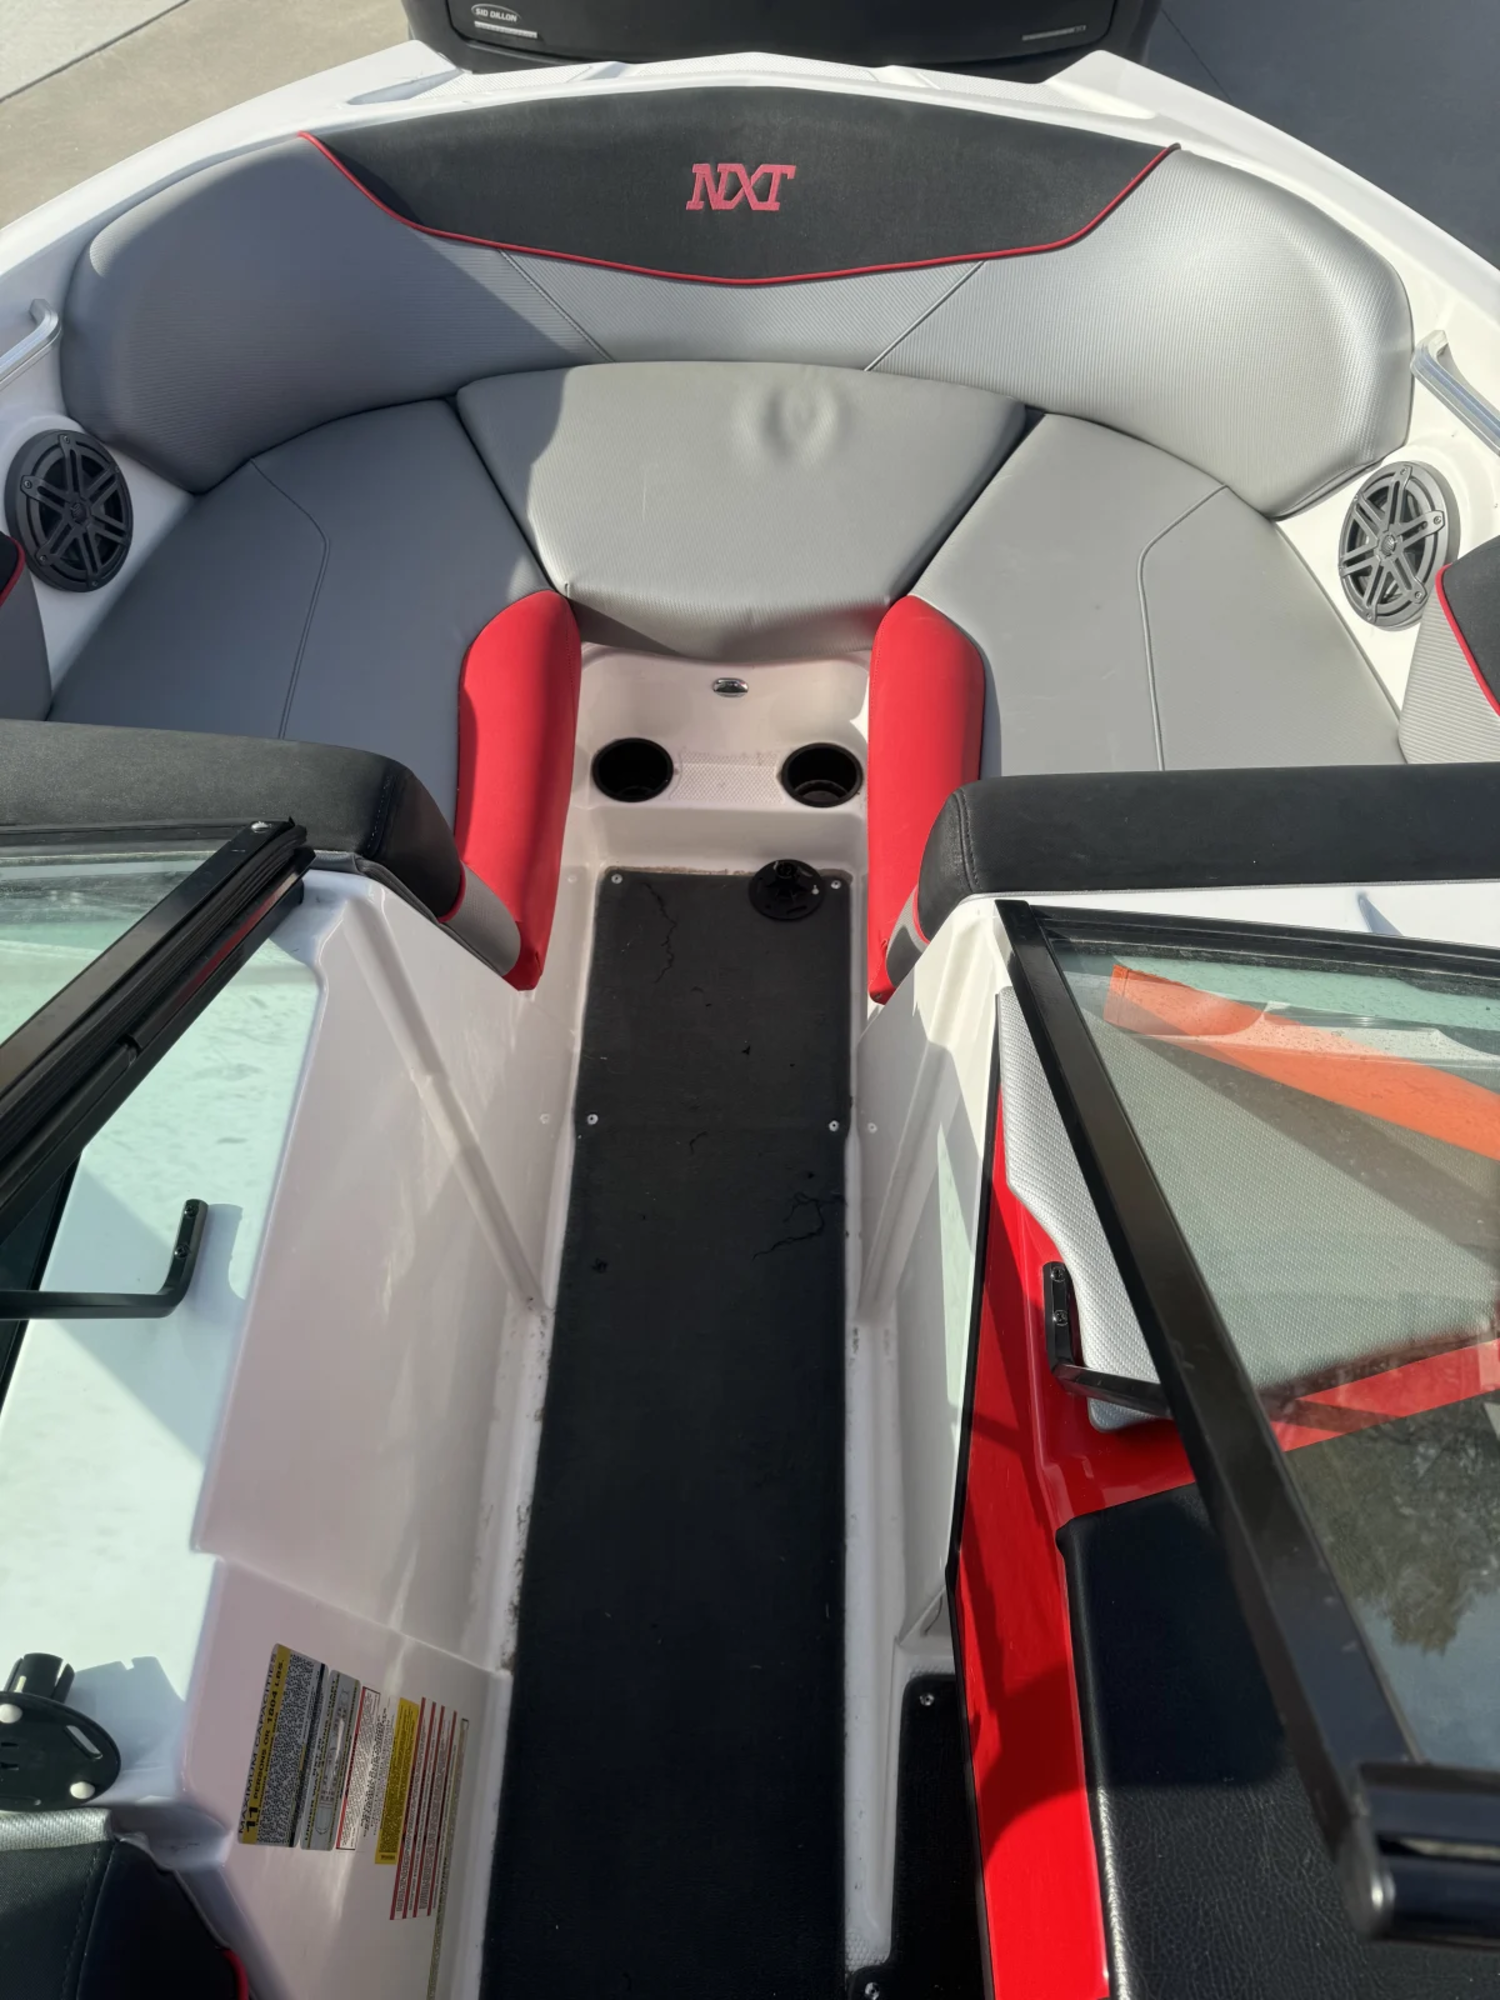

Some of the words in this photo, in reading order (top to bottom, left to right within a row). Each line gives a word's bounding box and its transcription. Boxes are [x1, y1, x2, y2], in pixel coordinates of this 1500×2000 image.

[475, 7, 489, 17] SID
[489, 10, 517, 22] DILLON
[685, 163, 797, 211] NXT
[238, 1753, 257, 1834] MAXIMUM
[253, 1653, 276, 1747] CAPACITIES
[246, 1807, 258, 1833] 11
[253, 1749, 267, 1799] PERSONS
